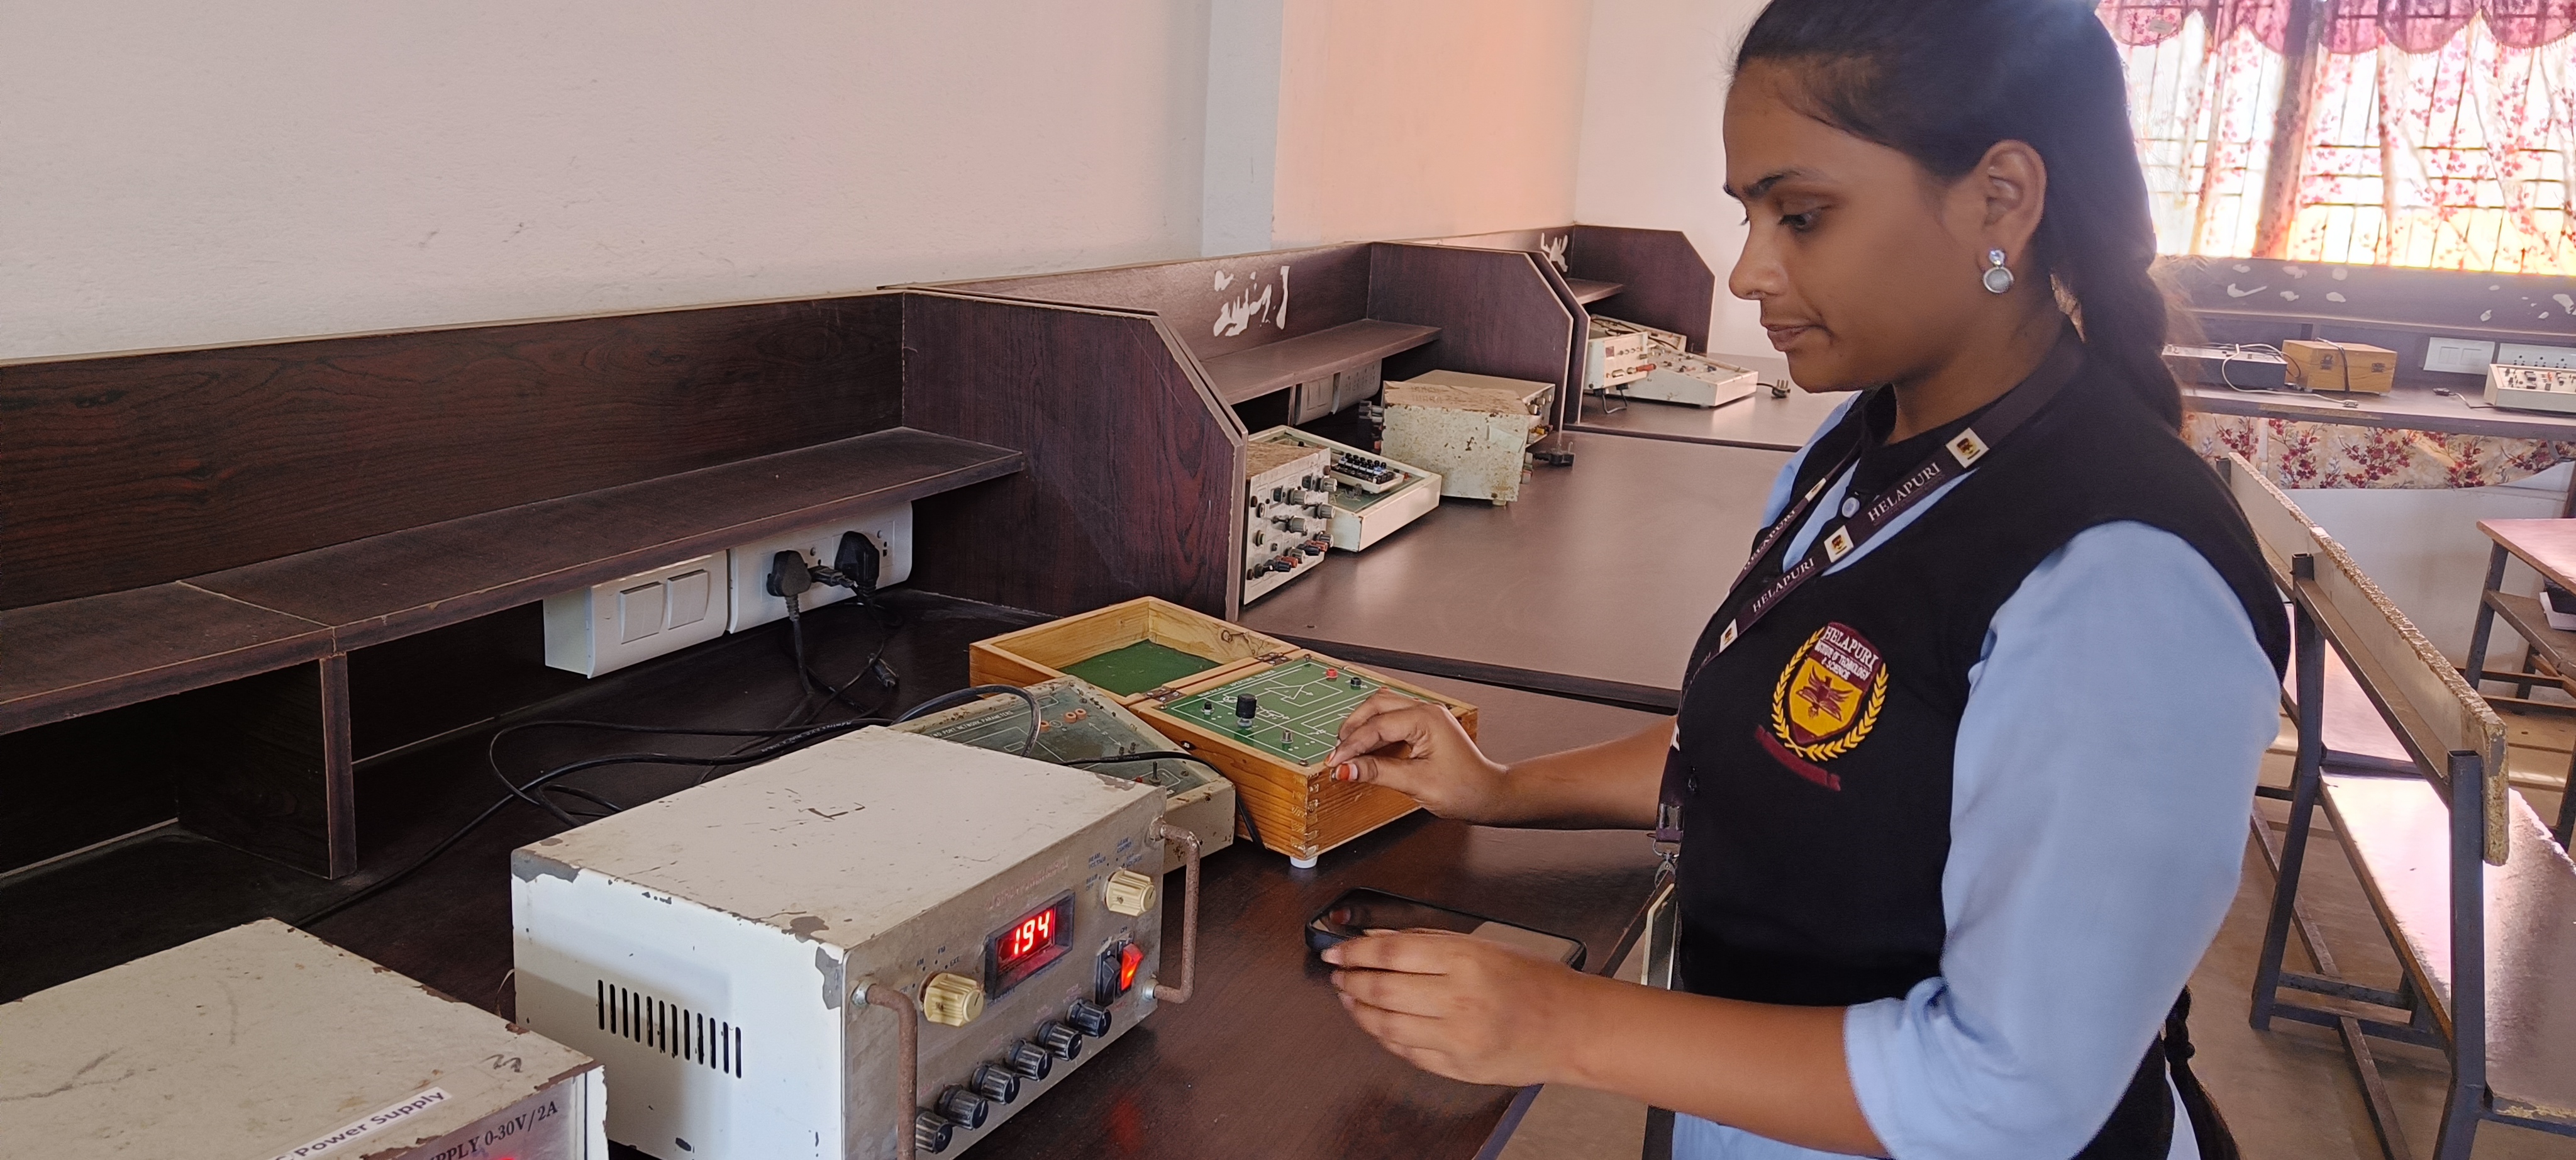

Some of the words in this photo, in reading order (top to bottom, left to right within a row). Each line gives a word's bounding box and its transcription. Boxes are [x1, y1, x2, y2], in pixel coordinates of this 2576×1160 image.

[1868, 462, 1941, 521] HELAPURI
[1753, 558, 1814, 613] HELAPURI
[1822, 626, 1879, 672] HELAPURI
[1014, 911, 1050, 955] 194
[294, 1124, 367, 1156] Power
[370, 1091, 444, 1125] Supply
[484, 1101, 558, 1146] 0-30V/2A
